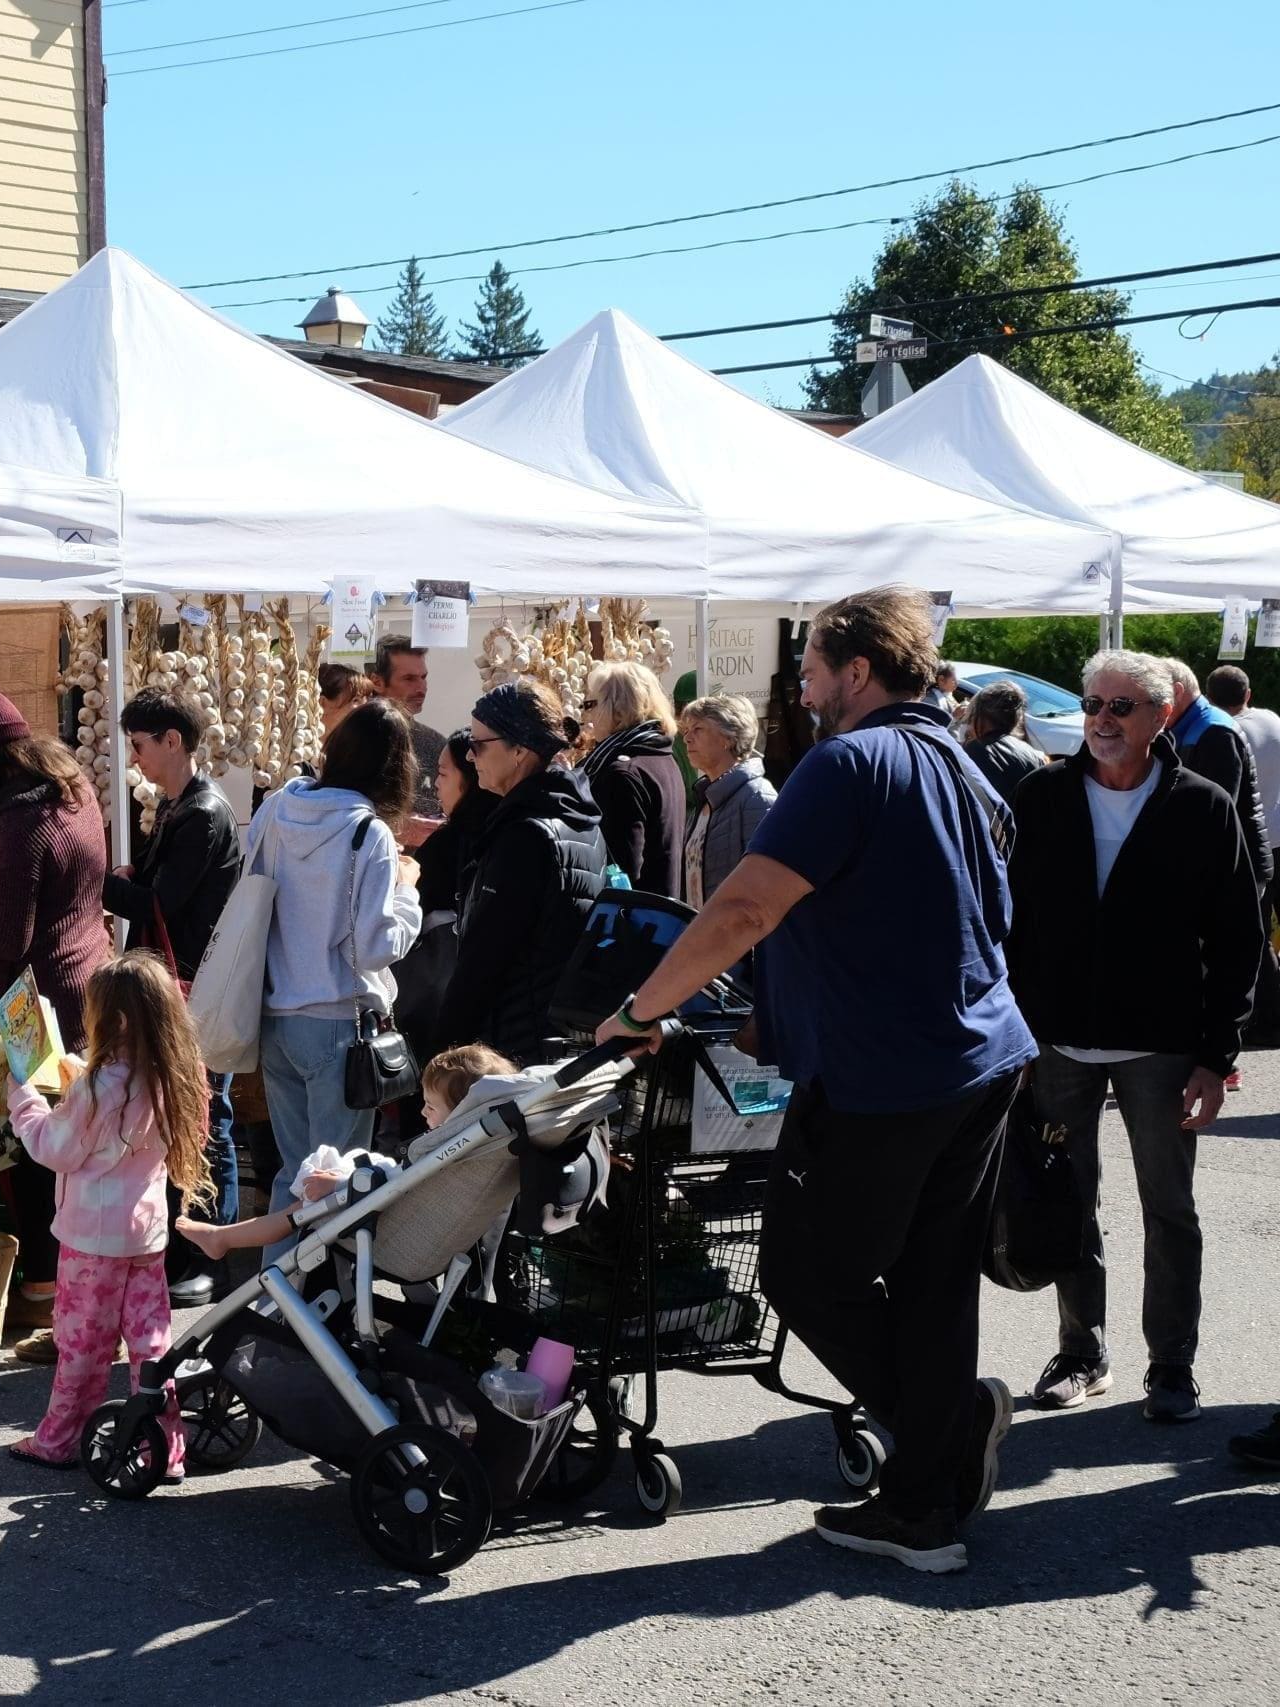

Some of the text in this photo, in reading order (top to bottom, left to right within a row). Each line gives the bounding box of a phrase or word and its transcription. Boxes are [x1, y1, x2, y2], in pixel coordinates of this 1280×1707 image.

[877, 348, 889, 358] de
[688, 623, 755, 649] HRITAGE
[708, 655, 754, 676] ARDIN
[436, 1136, 472, 1162] VISTA
